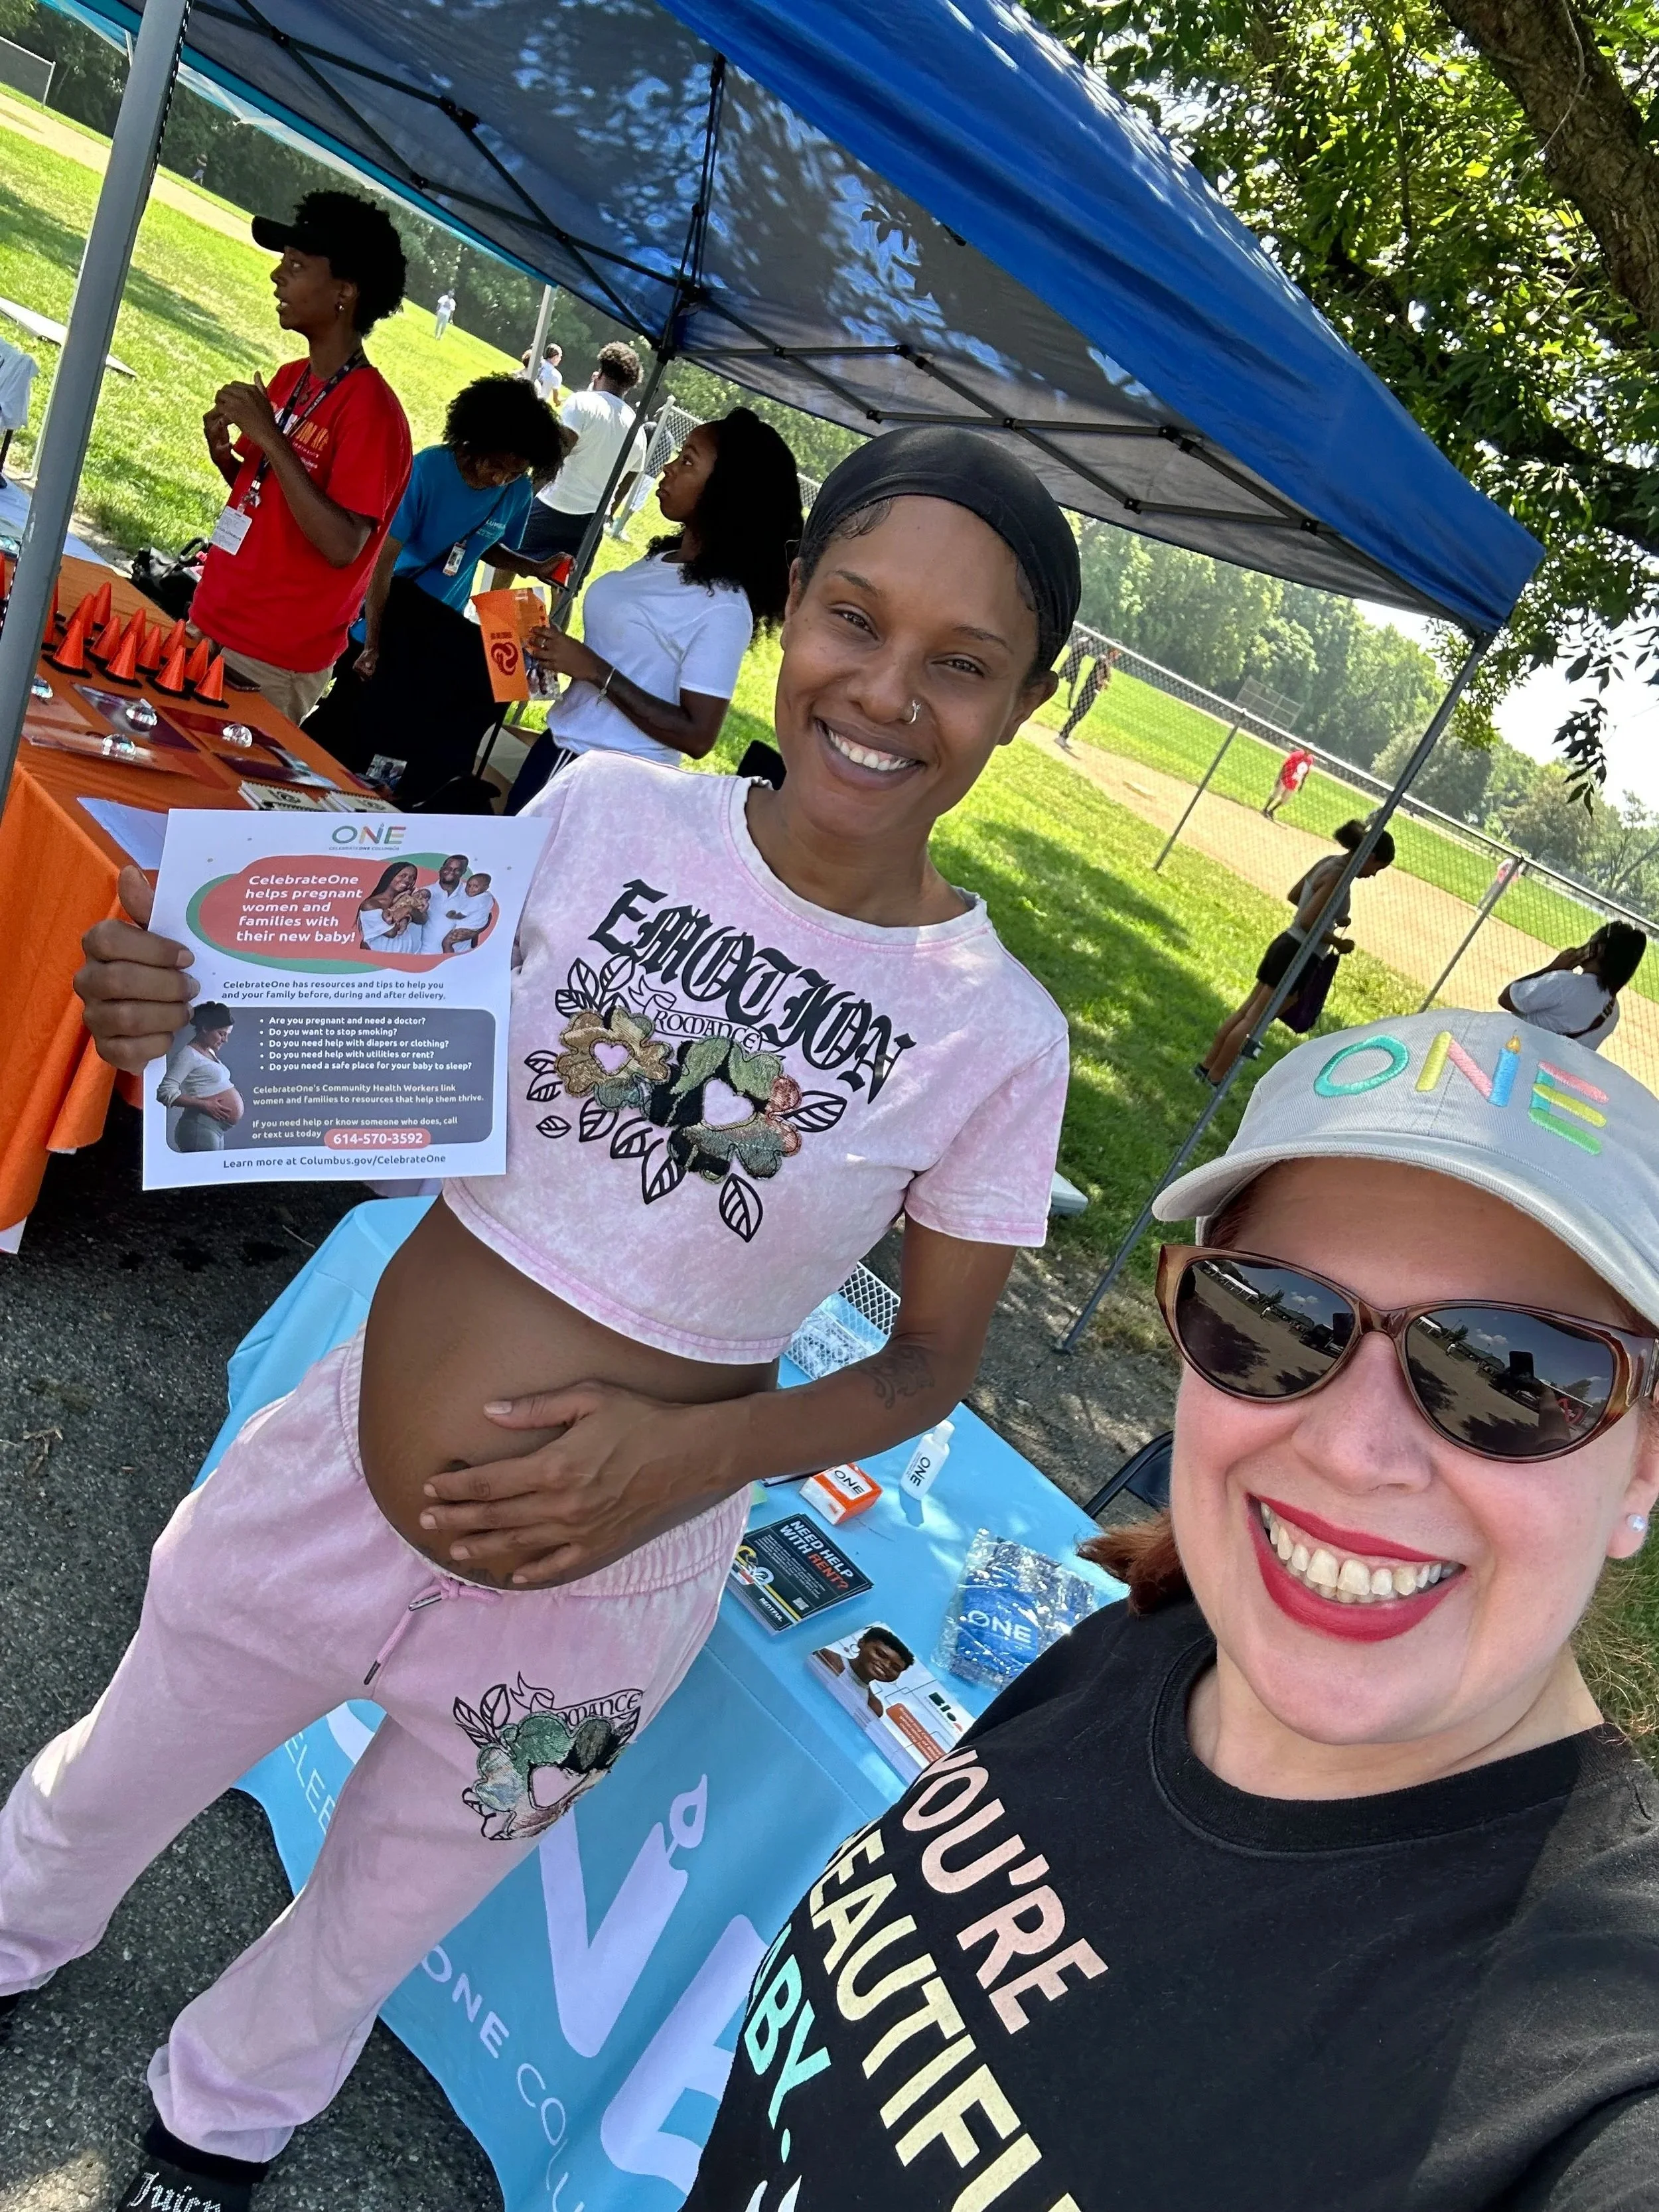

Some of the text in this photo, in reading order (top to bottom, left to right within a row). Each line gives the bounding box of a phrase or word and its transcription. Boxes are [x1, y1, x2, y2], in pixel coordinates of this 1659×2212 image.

[332, 823, 406, 844] ONE
[249, 875, 359, 885] CelebrateOne
[246, 889, 363, 900] helps pregnant
[242, 902, 332, 913] women and
[239, 915, 339, 927] families with
[236, 930, 356, 943] their new baby!
[376, 981, 393, 990] tips
[407, 981, 426, 990] help
[588, 879, 916, 1104] EMOTION
[242, 992, 264, 1000] your
[266, 991, 296, 1000] family
[298, 991, 332, 999] before,
[334, 991, 363, 1000] during
[408, 991, 446, 1000] delivery.
[305, 1017, 345, 1026] pregnant
[394, 1016, 426, 1025] doctor?
[337, 1029, 356, 1037] stop
[358, 1028, 397, 1037] smoking?
[654, 1009, 760, 1050] ROMANCE
[325, 1039, 344, 1048] help
[366, 1039, 397, 1049] diapers
[411, 1040, 449, 1049] clothing?
[325, 1051, 344, 1060] help
[352, 1062, 374, 1071] place
[412, 1062, 433, 1071] baby
[446, 1062, 472, 1071] sleep?
[253, 1083, 456, 1094] CelebrateOne's Community Health Workers link
[1314, 1031, 1609, 1155] ONE
[303, 1095, 338, 1104] families
[415, 1095, 434, 1104] help
[260, 1120, 277, 1129] you
[279, 1118, 301, 1127] need
[303, 1118, 322, 1127] help
[296, 1130, 321, 1140] today
[332, 1133, 423, 1145] 614-570-3592
[224, 1159, 253, 1169] Learn
[285, 1157, 297, 1166] at
[300, 1154, 446, 1166] Columbus.gov/CelebrateOne
[910, 1456, 931, 1487] ONE
[834, 1469, 865, 1495] ONE
[790, 1520, 824, 1550] NEED
[820, 1548, 854, 1578] HELP
[780, 1524, 813, 1554] WITH
[808, 1553, 849, 1589] RENT?
[968, 1609, 1031, 1644] ONE
[903, 1746, 1108, 2035] YOU'RE
[420, 1943, 510, 2060] ONE
